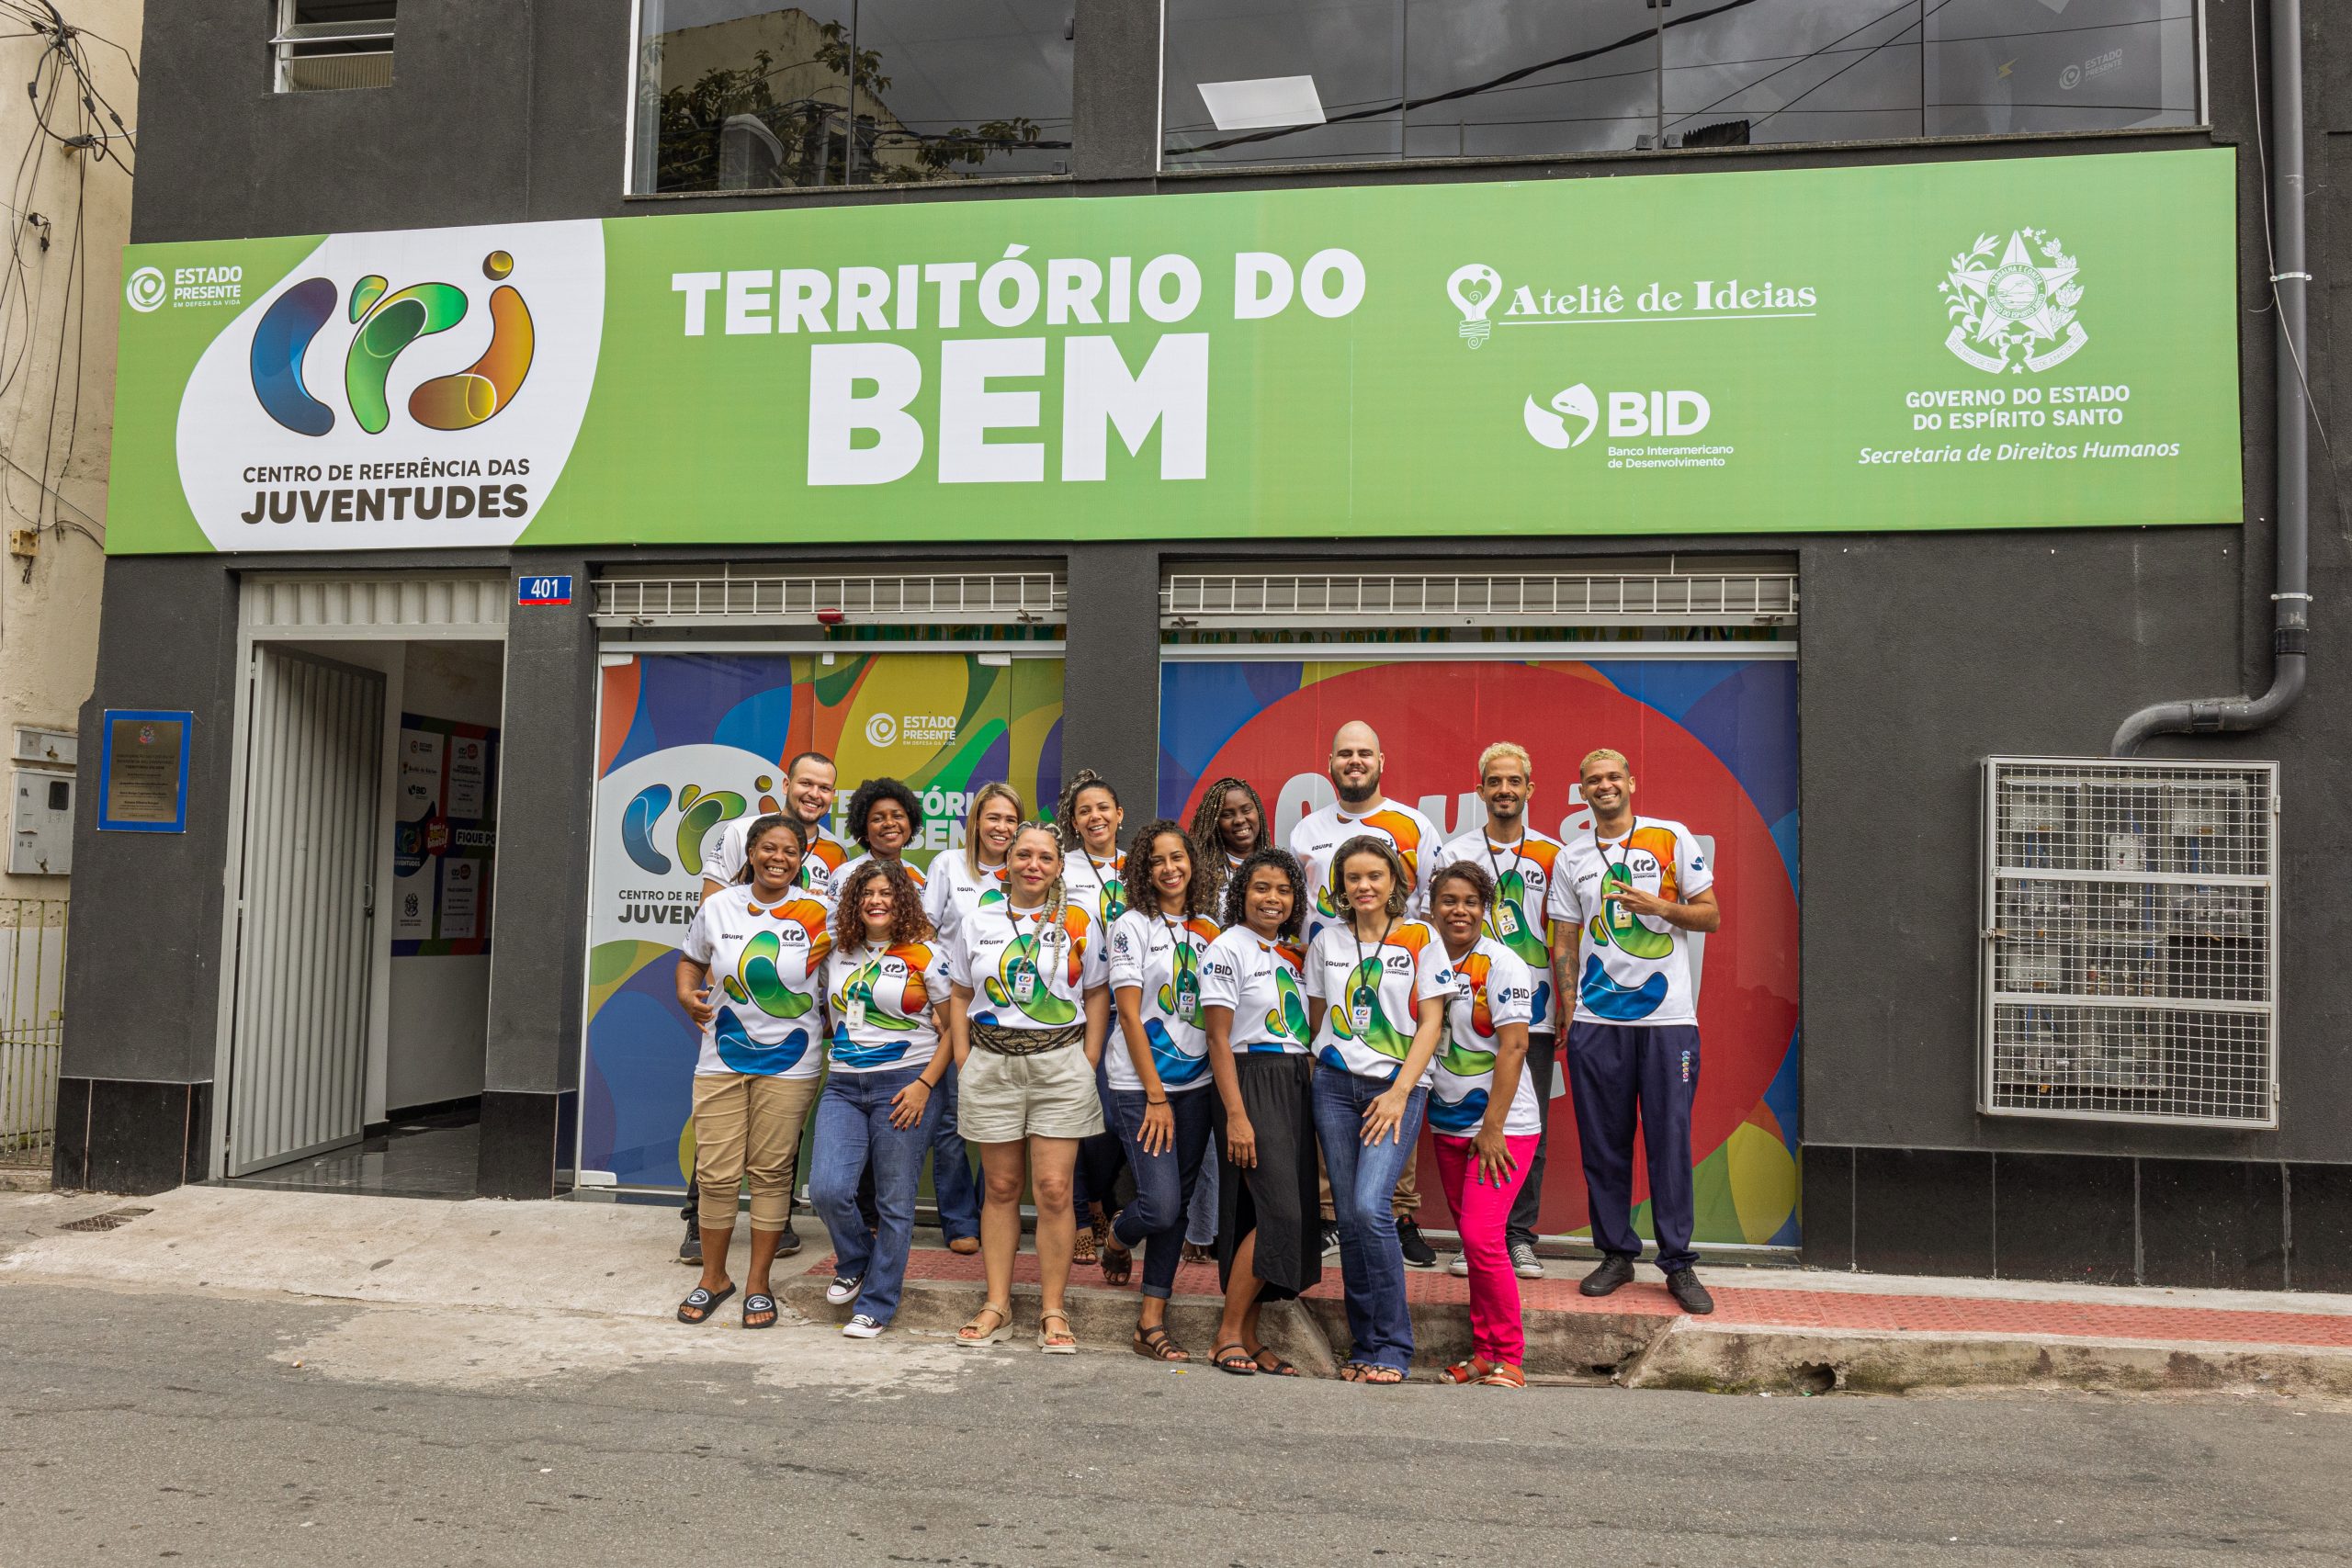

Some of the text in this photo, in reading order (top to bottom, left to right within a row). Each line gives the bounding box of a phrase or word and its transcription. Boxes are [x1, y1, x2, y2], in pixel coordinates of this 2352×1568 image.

[175, 266, 243, 285] ESTADO
[174, 285, 242, 300] PRESENTE
[672, 243, 1366, 336] TERRITÓRIO DO
[1504, 279, 1817, 315] Ateliê de Ideias
[1905, 385, 2130, 408] GOVERNO DO ESTADO
[808, 333, 1209, 486] BEM
[1609, 390, 1711, 437] BID
[1913, 408, 2123, 431] DO ESPÍRITO SANTO
[1608, 444, 1734, 456] Banco Interamericano
[1858, 441, 2180, 465] Secretaria de Direitos Humanos
[243, 457, 530, 483] CENTRO DE REFERÊNCIA DAS
[1608, 457, 1725, 468] de Desenvolvimento
[241, 483, 529, 525] JUVENTUDES
[531, 579, 558, 598] 401
[903, 716, 956, 728] ESTADO
[903, 730, 956, 739] PRESENTE
[457, 830, 483, 844] FIQUE
[485, 833, 496, 844] PO
[1311, 842, 1333, 852] EQUIPE
[1578, 872, 1598, 884] EQUIPE
[618, 890, 664, 900] CENTRO
[668, 891, 682, 900] DE
[618, 904, 700, 924] JUVEN
[1214, 964, 1233, 976] BID
[1325, 960, 1350, 968] EQUIPE
[1512, 987, 1530, 999] BID
